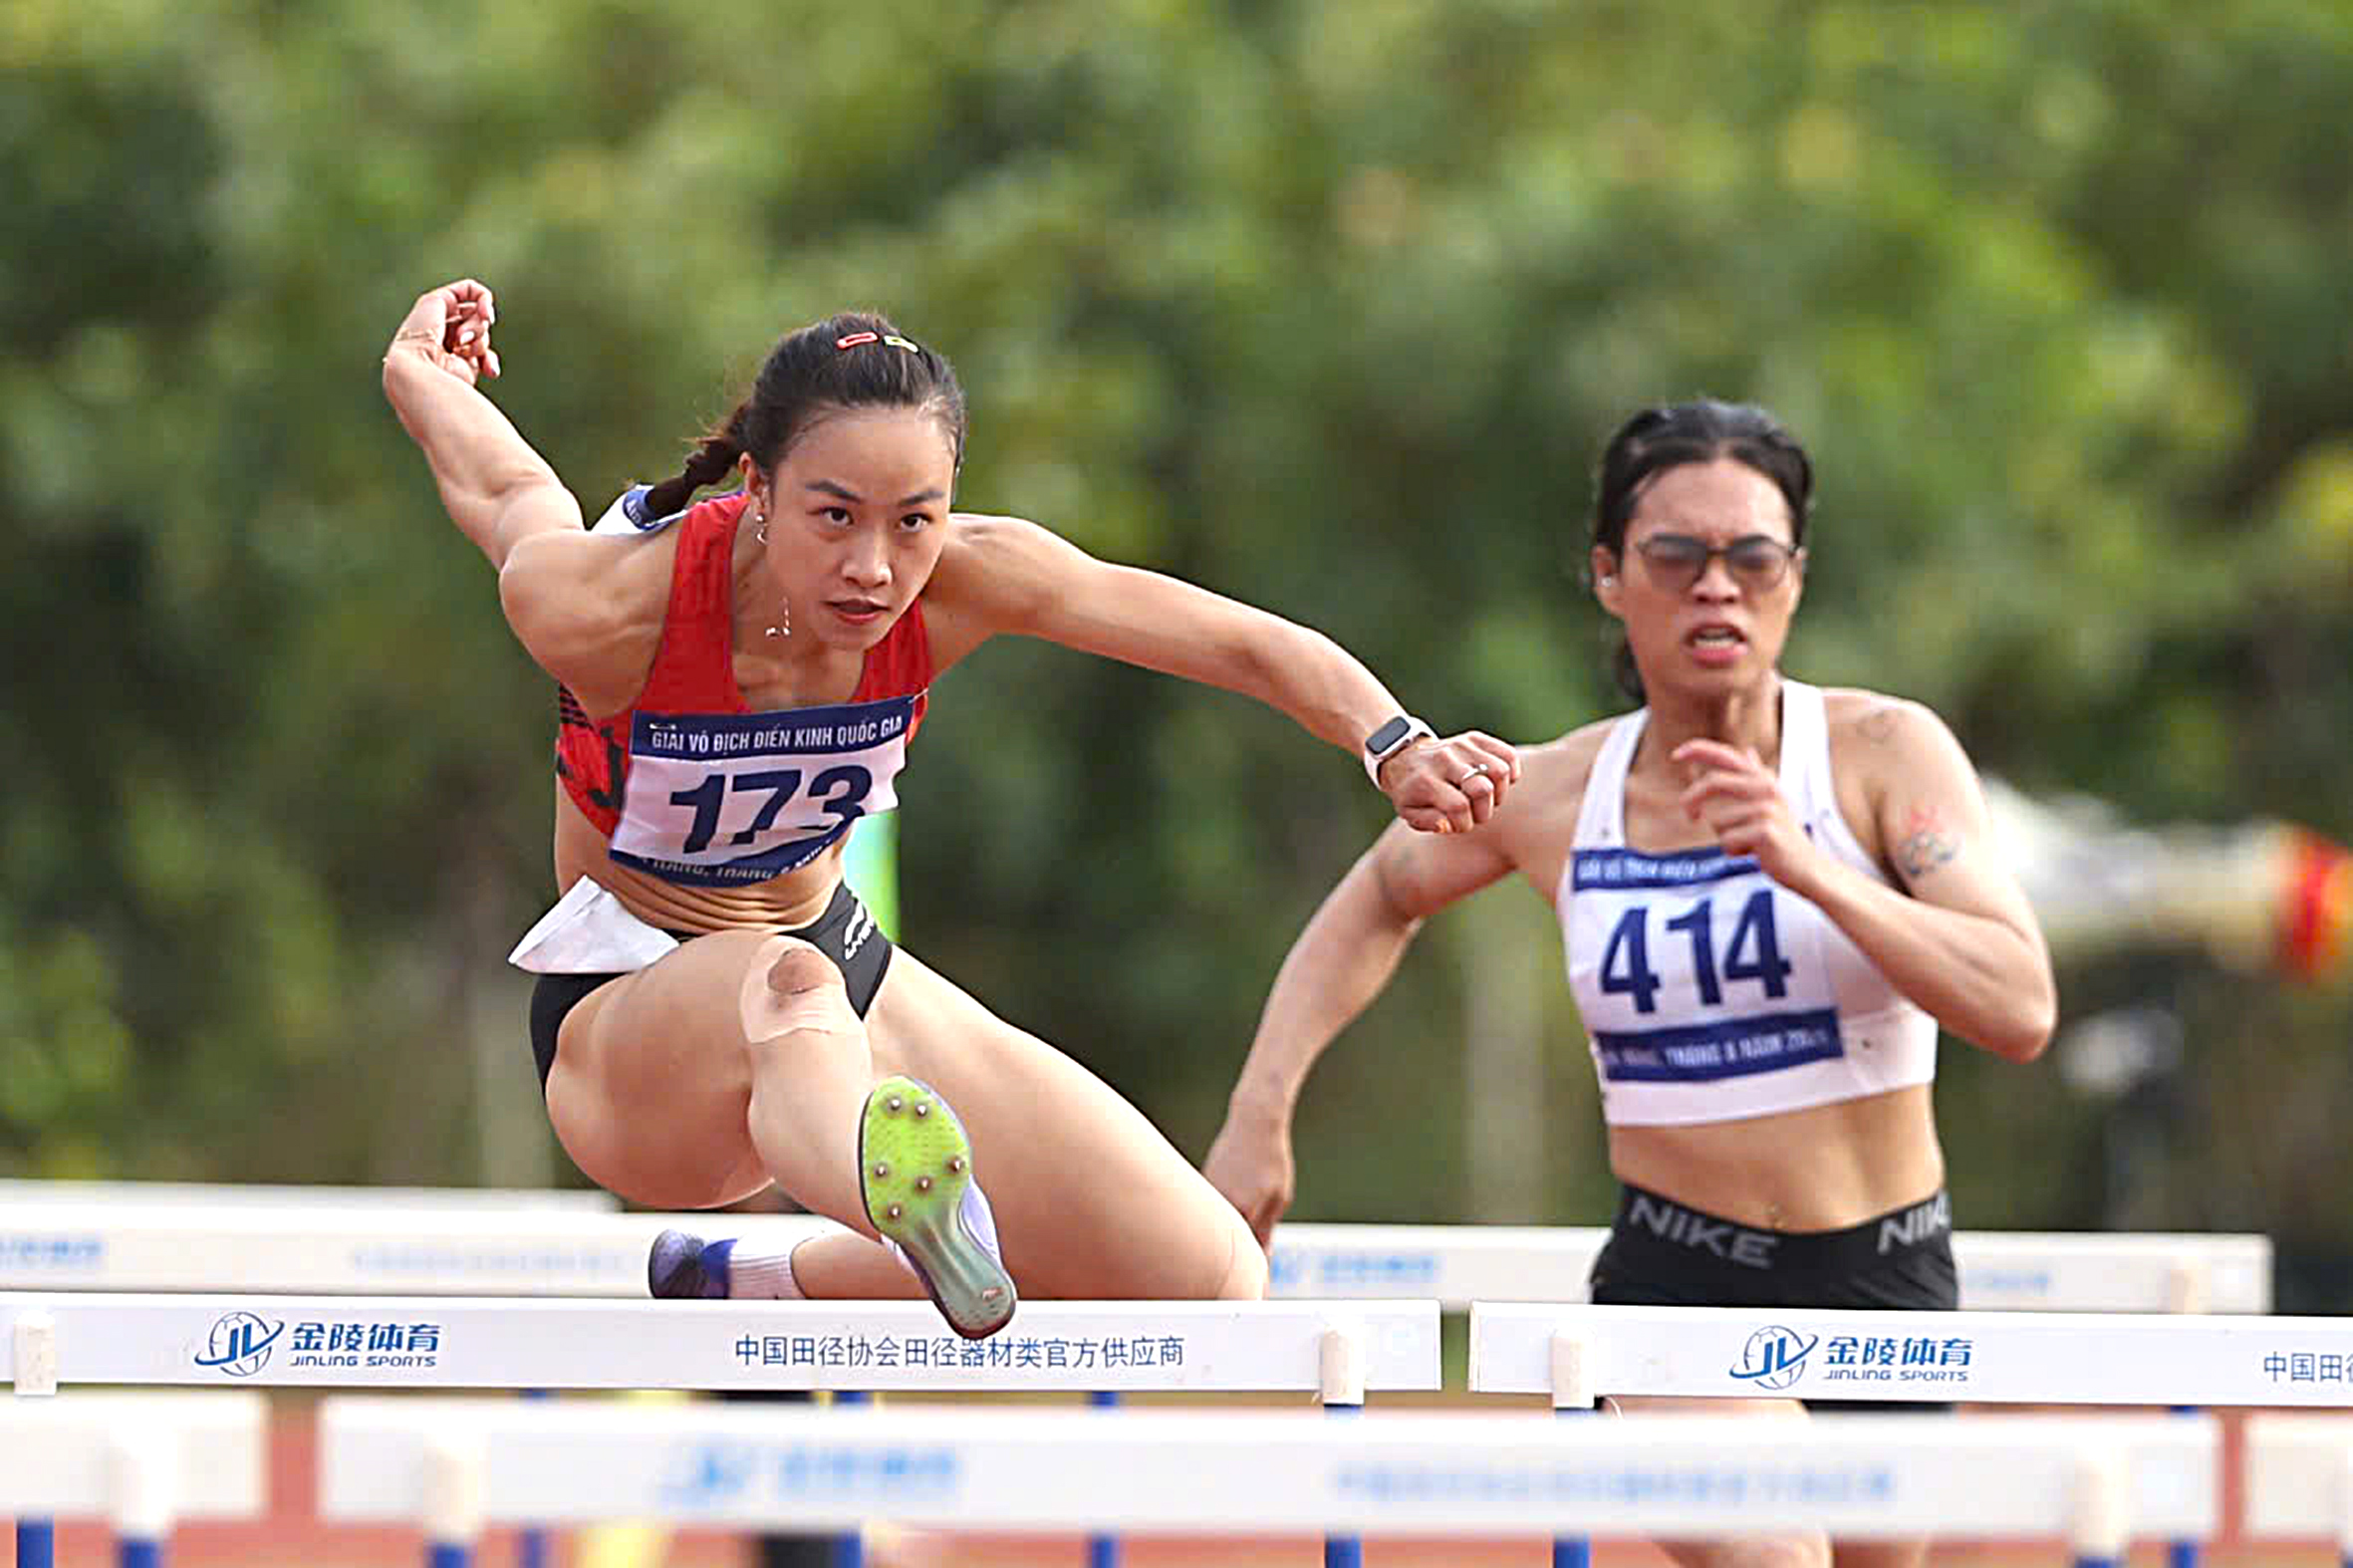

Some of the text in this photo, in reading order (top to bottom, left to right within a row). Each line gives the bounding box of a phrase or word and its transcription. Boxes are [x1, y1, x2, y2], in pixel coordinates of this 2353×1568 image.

[795, 727, 833, 747] KINH
[881, 715, 903, 737] GIA
[670, 764, 873, 854] 173
[1599, 890, 1792, 1014] 414
[1628, 1196, 1780, 1269] NIKE
[290, 1322, 440, 1352] 金陵体育
[734, 1335, 1184, 1369] 中国田径协会田径器材类官方供应商
[1824, 1336, 1973, 1366] 金陵体育
[290, 1356, 437, 1367] JINLING SPORTS
[1823, 1369, 1968, 1382] JINLING SPORTS
